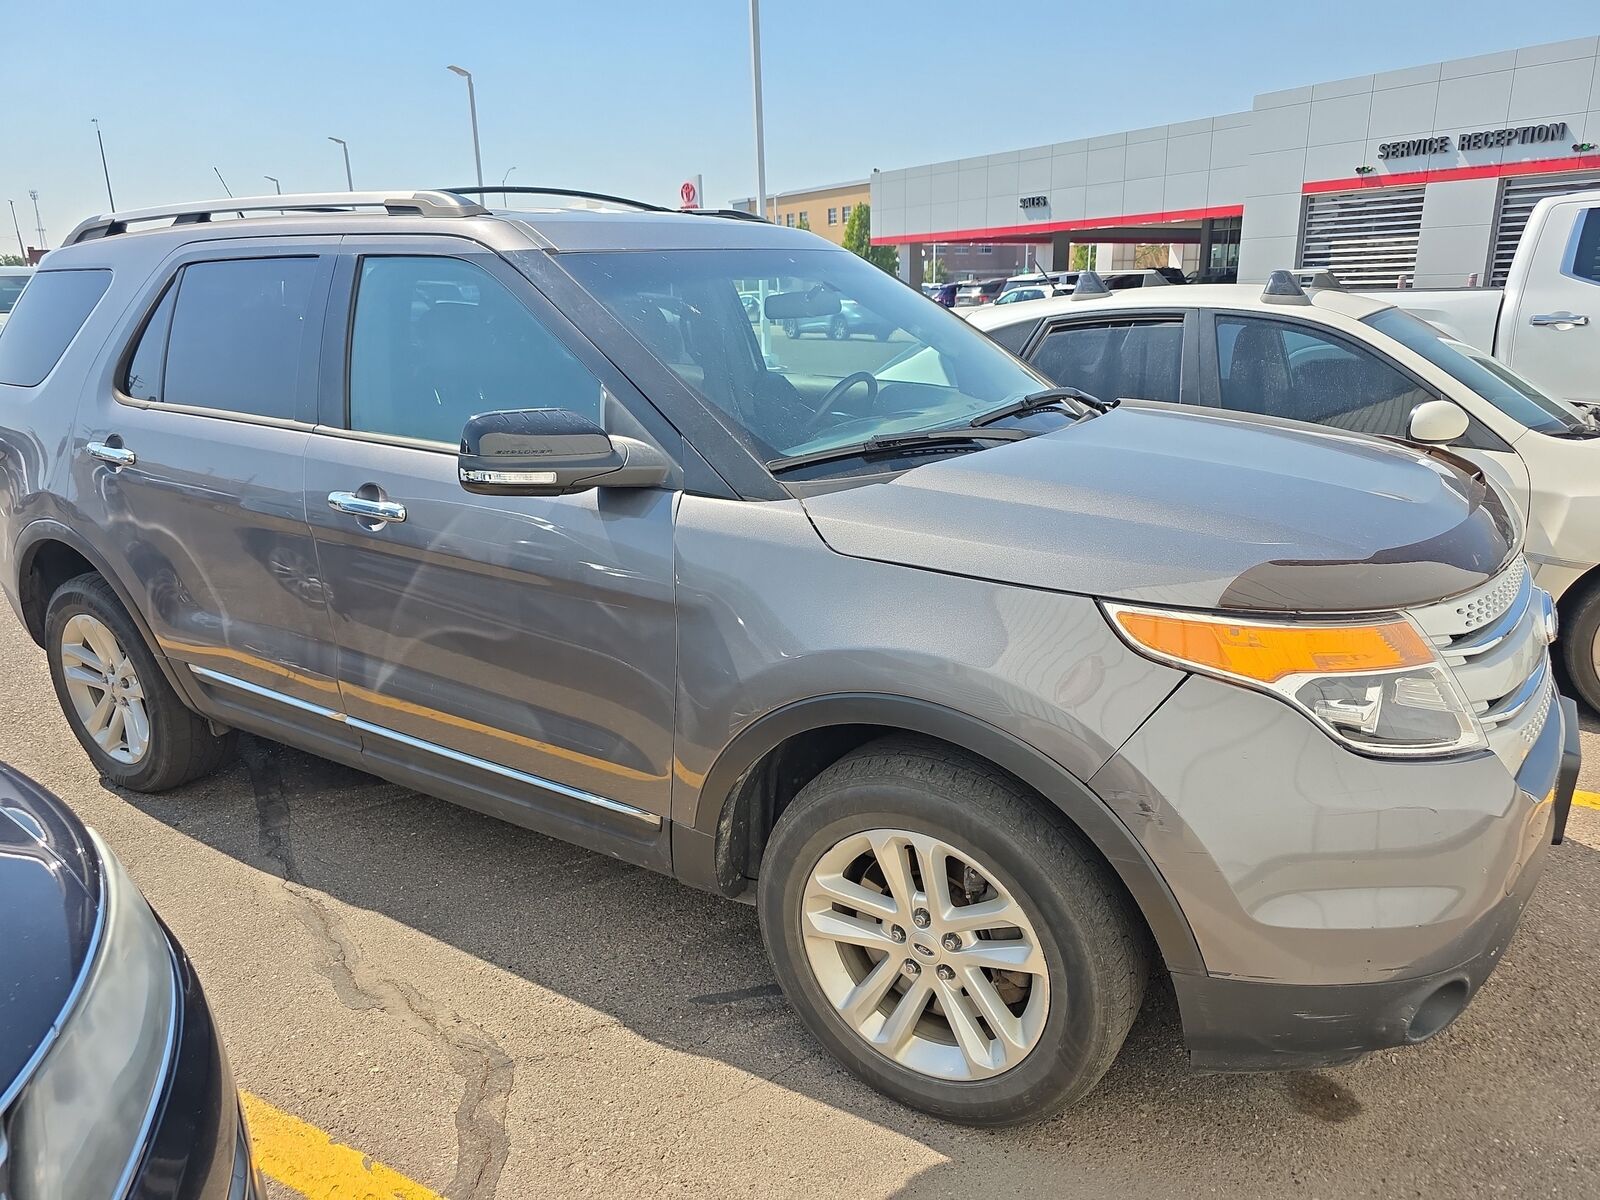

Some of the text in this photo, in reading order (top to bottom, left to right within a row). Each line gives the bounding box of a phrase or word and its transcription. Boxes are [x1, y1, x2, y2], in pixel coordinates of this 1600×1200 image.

[1378, 122, 1566, 160] SERVICE RECEPTION
[1019, 195, 1048, 208] SALES
